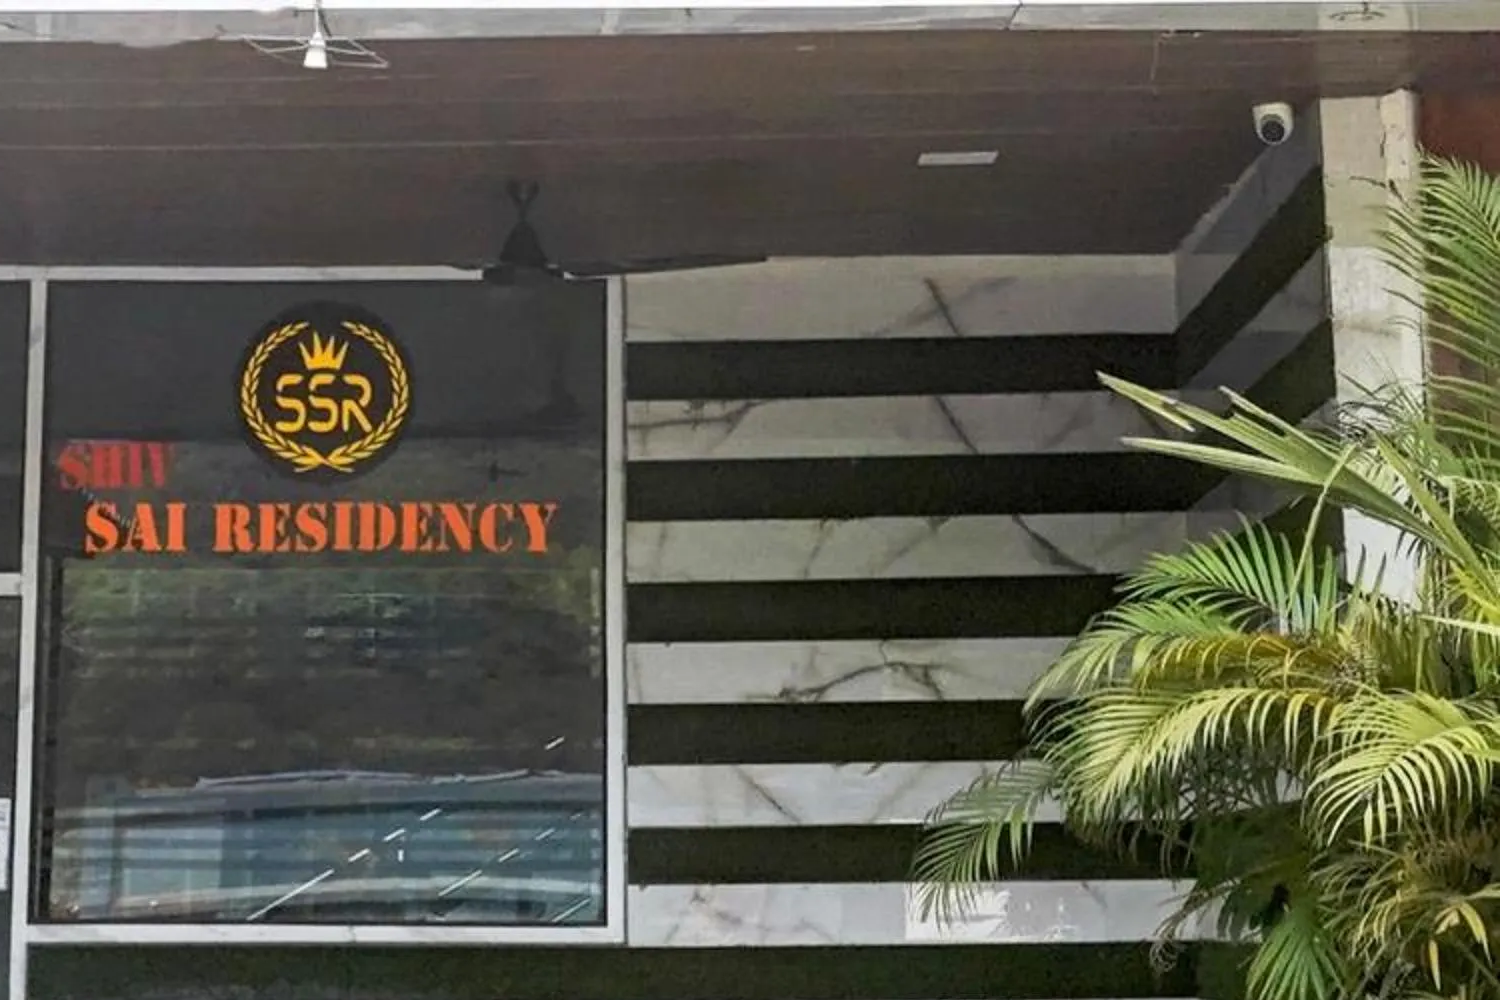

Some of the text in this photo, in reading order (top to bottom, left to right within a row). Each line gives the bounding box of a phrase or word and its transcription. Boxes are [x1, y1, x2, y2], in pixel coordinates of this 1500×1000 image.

[275, 373, 374, 434] SSR
[85, 501, 559, 554] SAI RESIDENCY
